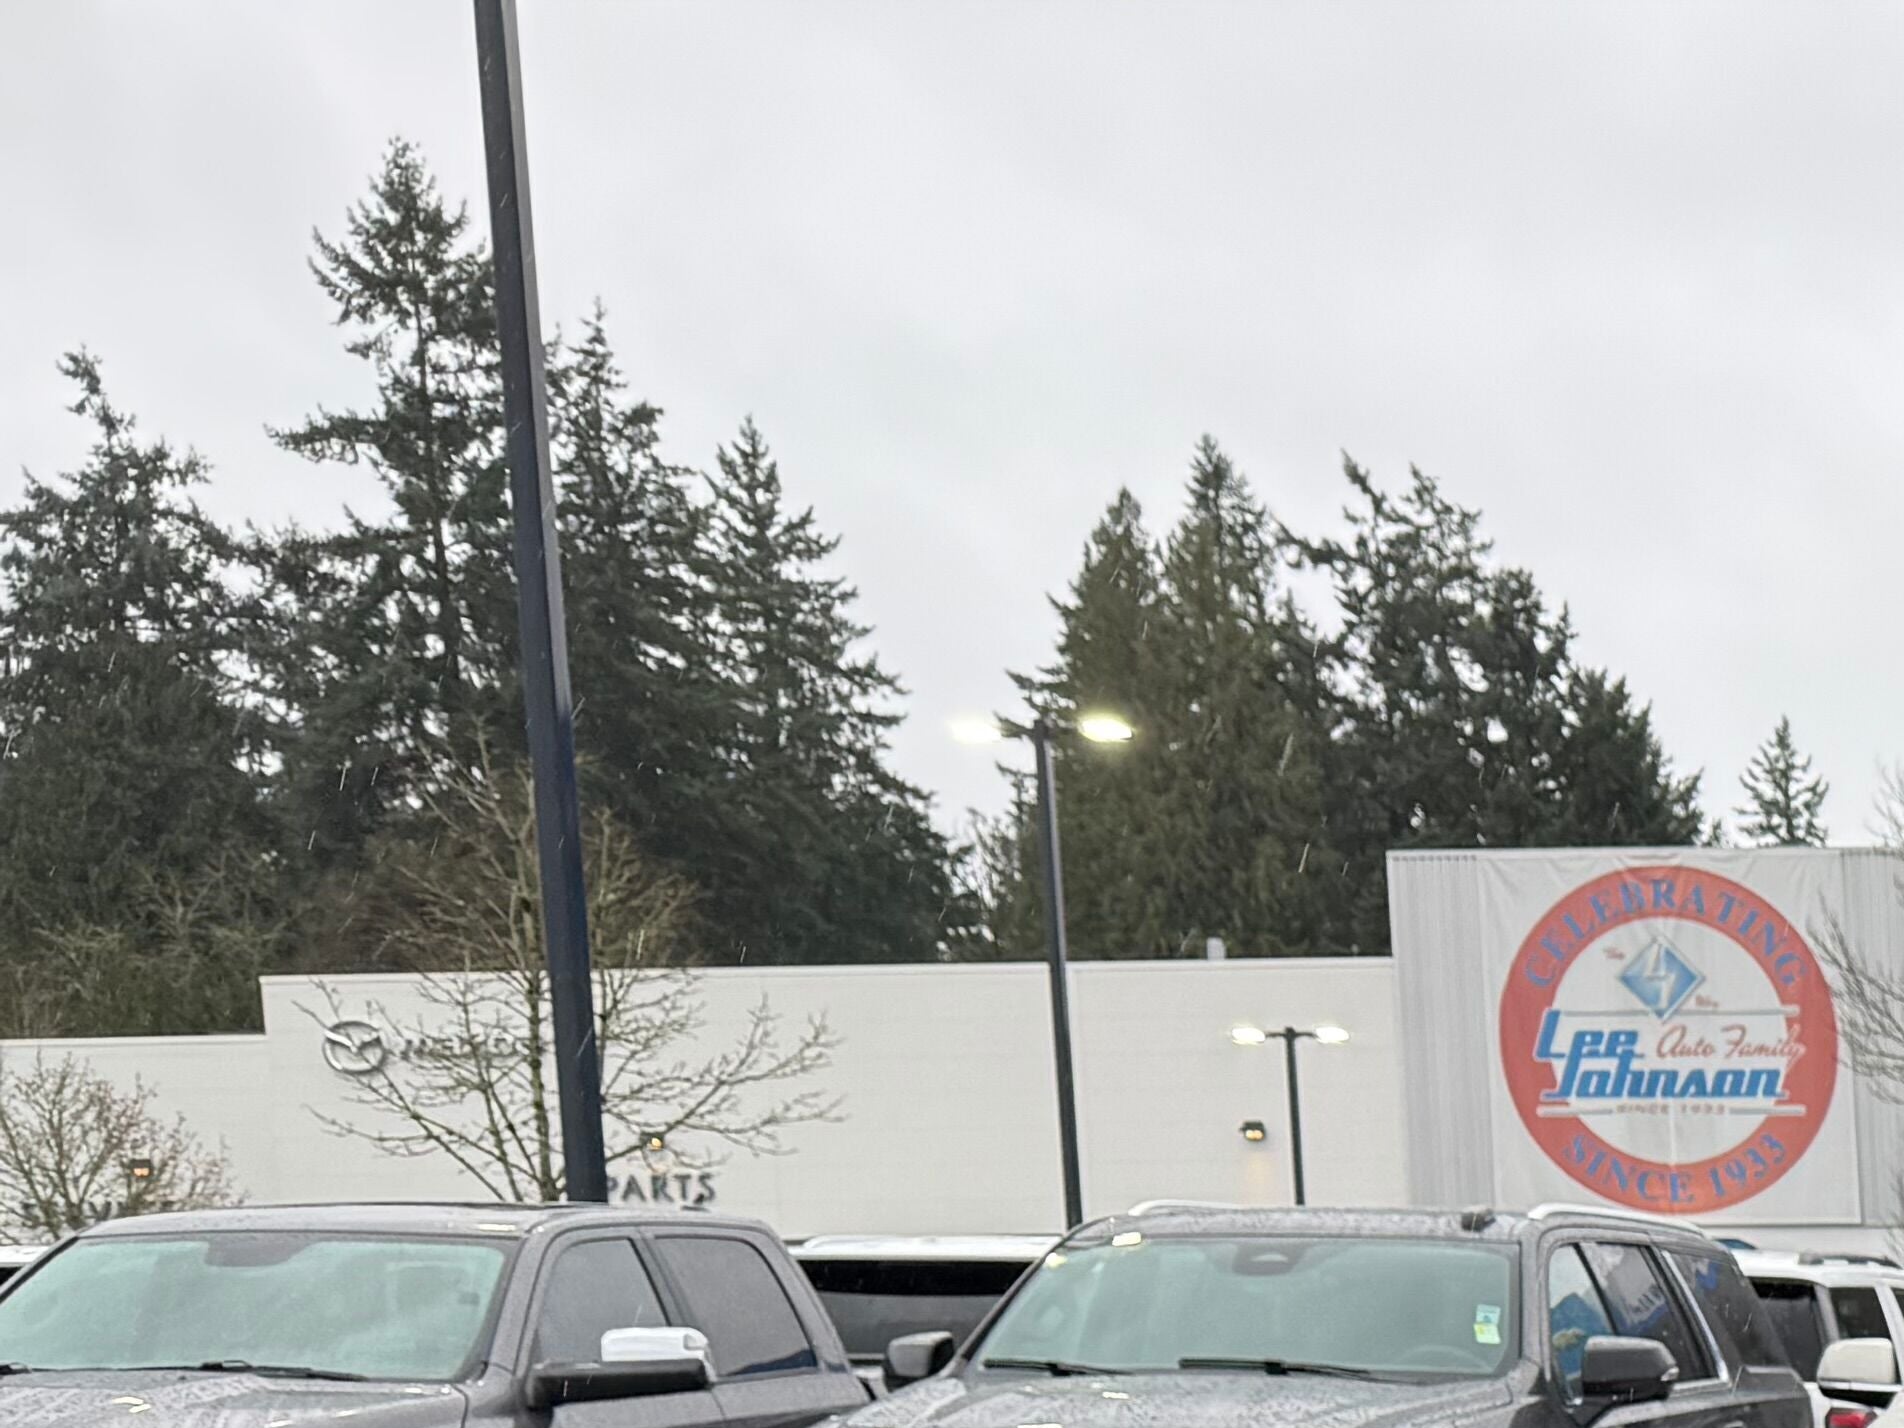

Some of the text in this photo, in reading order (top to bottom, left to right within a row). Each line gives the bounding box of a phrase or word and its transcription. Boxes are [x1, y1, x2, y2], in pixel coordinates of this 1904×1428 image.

[1524, 878, 1807, 988] CELEBRATING
[1536, 1010, 1805, 1067] Lee Auto Family
[1541, 1050, 1787, 1098] Johnson
[1562, 1133, 1787, 1204] SINCE 1933
